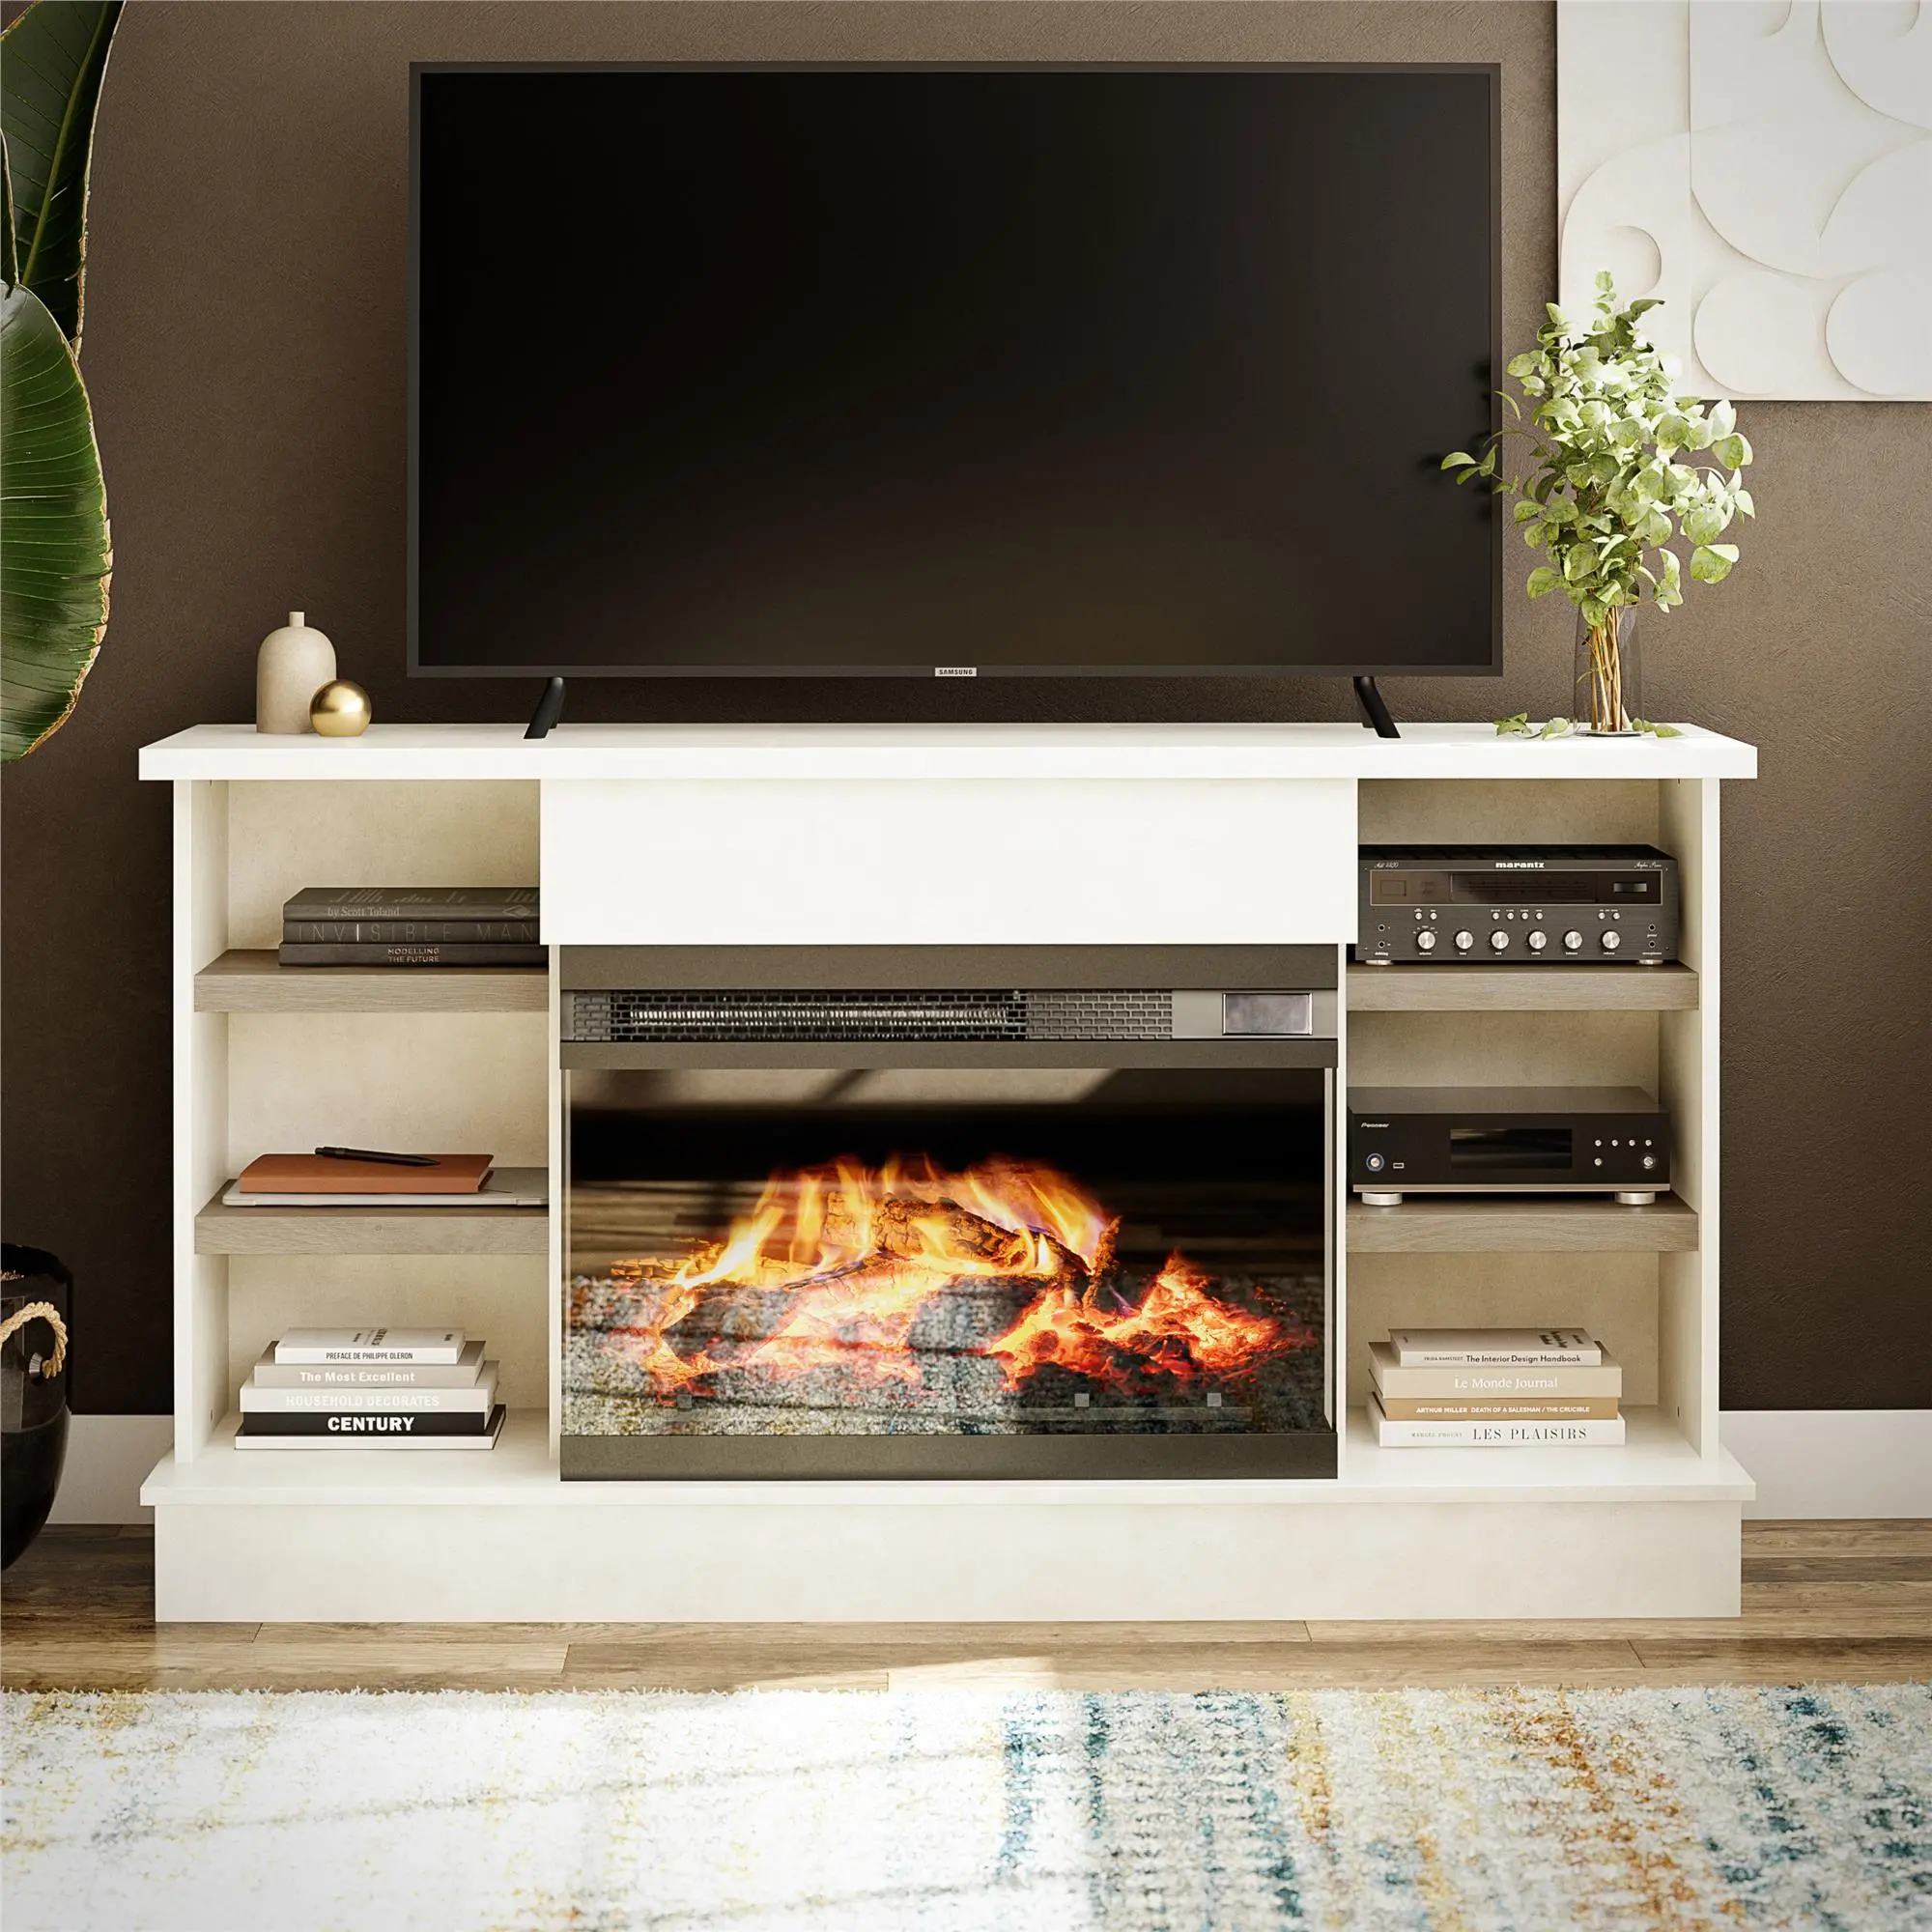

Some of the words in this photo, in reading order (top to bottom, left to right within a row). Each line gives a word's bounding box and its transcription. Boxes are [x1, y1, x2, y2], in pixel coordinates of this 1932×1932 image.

[327, 907, 339, 919] by
[341, 907, 365, 917] Scott
[476, 923, 533, 942] MAN
[326, 1351, 352, 1360] PREFACE
[354, 1351, 360, 1360] DE
[362, 1351, 388, 1360] PHILIPPE
[389, 1351, 413, 1360] OLERON
[1511, 1354, 1539, 1364] Design
[300, 1372, 321, 1382] The
[326, 1372, 355, 1382] Most
[359, 1372, 415, 1382] Excellent
[1455, 1378, 1467, 1388] Le
[1472, 1378, 1512, 1388] Monde
[1516, 1378, 1558, 1389] Journal
[286, 1395, 363, 1406] HOUSEHOLD
[367, 1395, 440, 1406] DECORATES
[327, 1417, 414, 1432] CENTURY
[1473, 1428, 1502, 1440] LES
[1511, 1428, 1587, 1440] PLAISIRS
